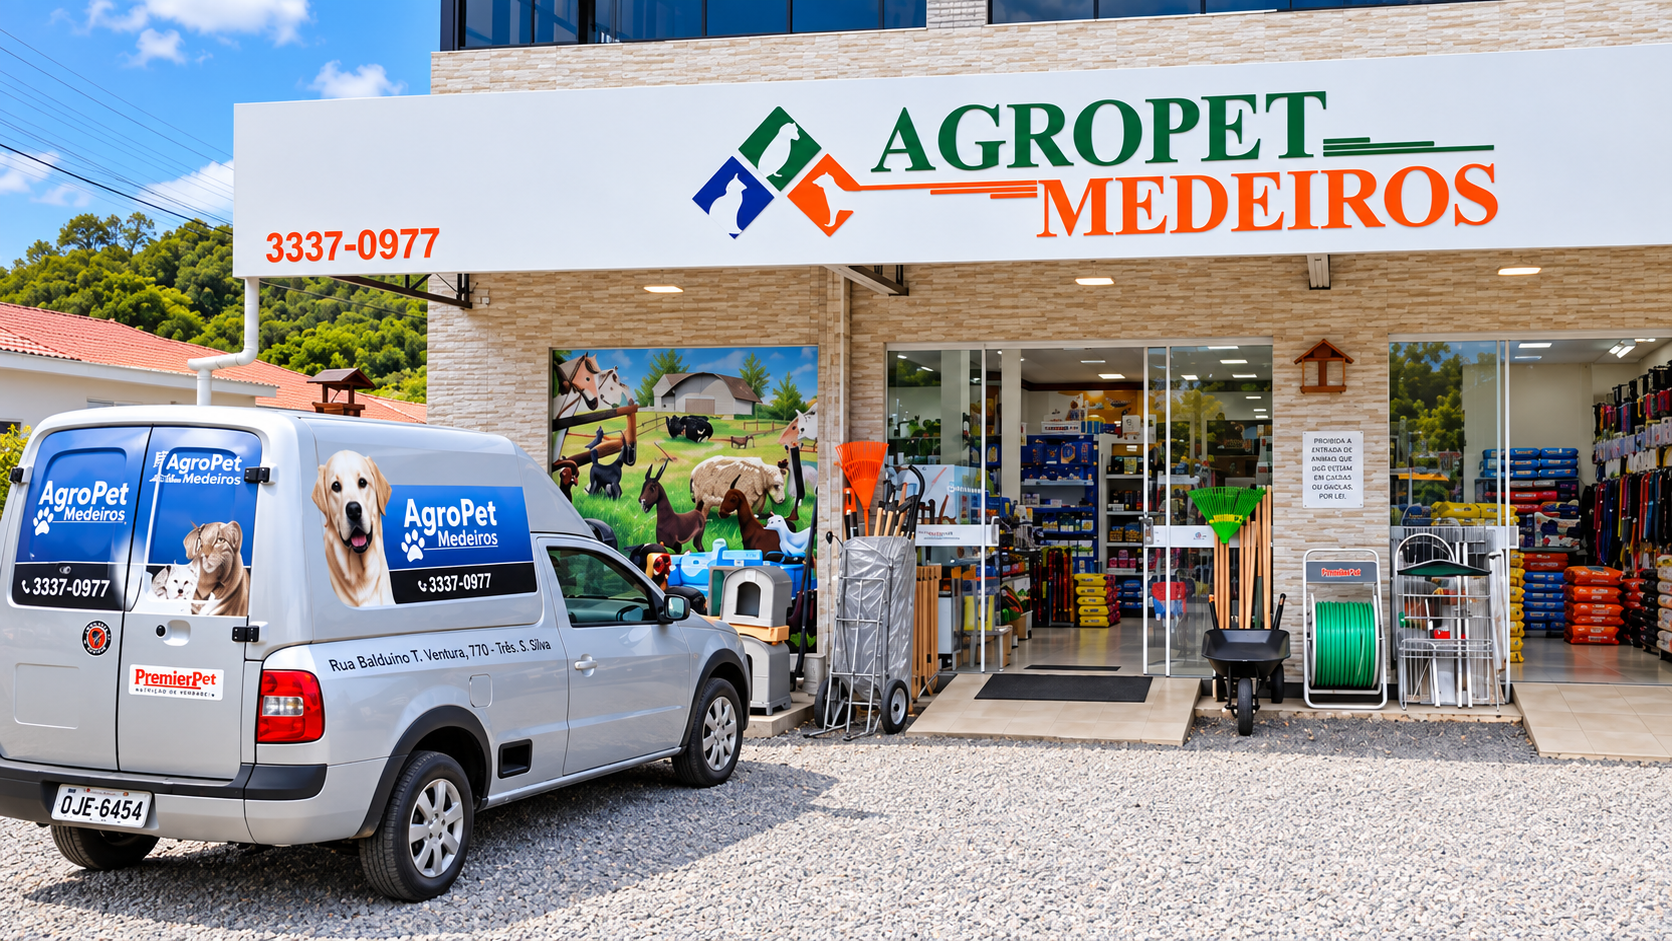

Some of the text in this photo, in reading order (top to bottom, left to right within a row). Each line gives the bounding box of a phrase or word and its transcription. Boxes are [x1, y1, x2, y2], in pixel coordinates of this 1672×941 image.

[870, 91, 1326, 173] AGROPET
[1036, 163, 1498, 238] MEDEIROS
[265, 227, 440, 263] 3337-0977
[166, 453, 242, 474] AgroPet
[182, 473, 241, 485] Medeiros
[38, 480, 129, 512] AgroPet
[64, 507, 125, 521] Medeiros
[404, 498, 498, 536] AgroPet
[438, 530, 498, 547] Medeiros
[32, 577, 110, 598] 3337-0977
[428, 572, 492, 593] 3337-0977
[328, 659, 356, 672] Rua
[356, 652, 410, 669] Balduino
[410, 649, 423, 662] T.
[423, 644, 469, 661] Ventura,
[468, 643, 489, 657] 770
[518, 639, 529, 652] S.
[134, 668, 217, 688] PremierPet
[60, 795, 144, 821] OJE-6454
